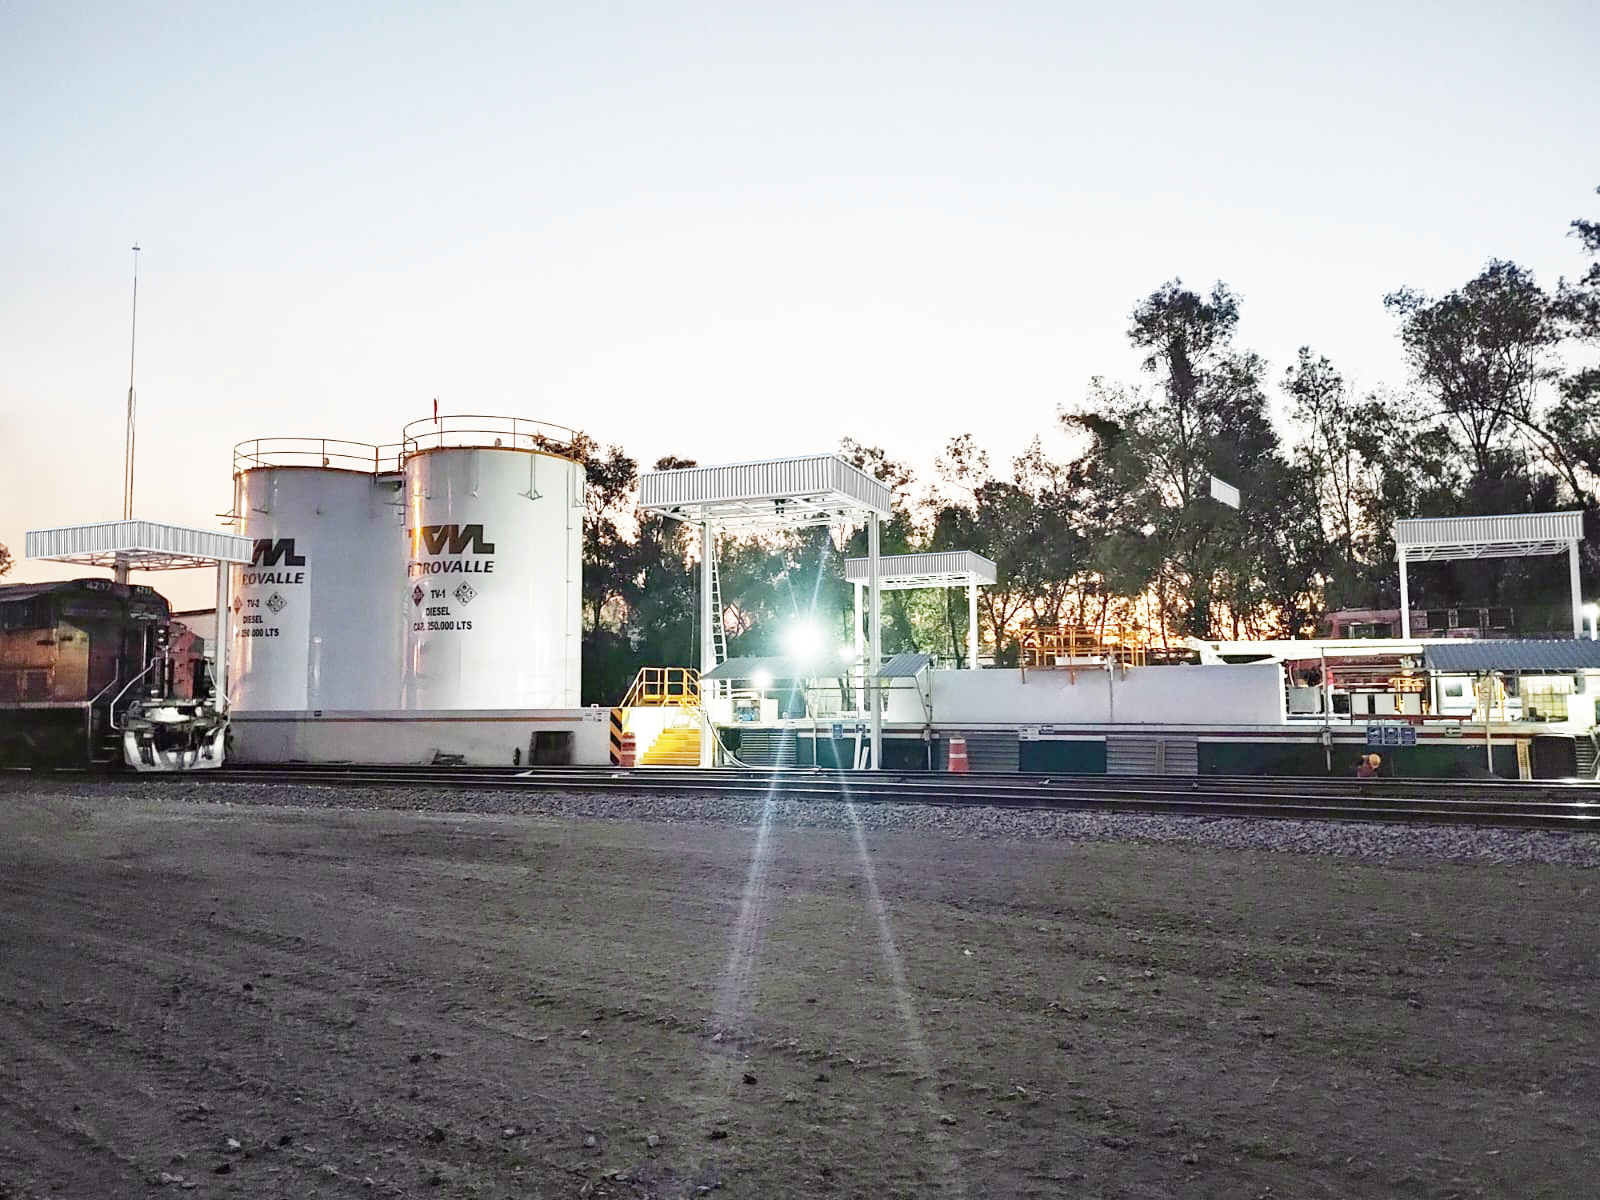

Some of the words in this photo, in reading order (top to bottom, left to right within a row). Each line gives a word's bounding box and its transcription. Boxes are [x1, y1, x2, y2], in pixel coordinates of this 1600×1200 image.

[430, 589, 446, 599] TV-1
[425, 606, 451, 617] DIESEL
[242, 615, 264, 624] DIESEL
[456, 620, 473, 630] LTS
[265, 628, 280, 637] LTS
